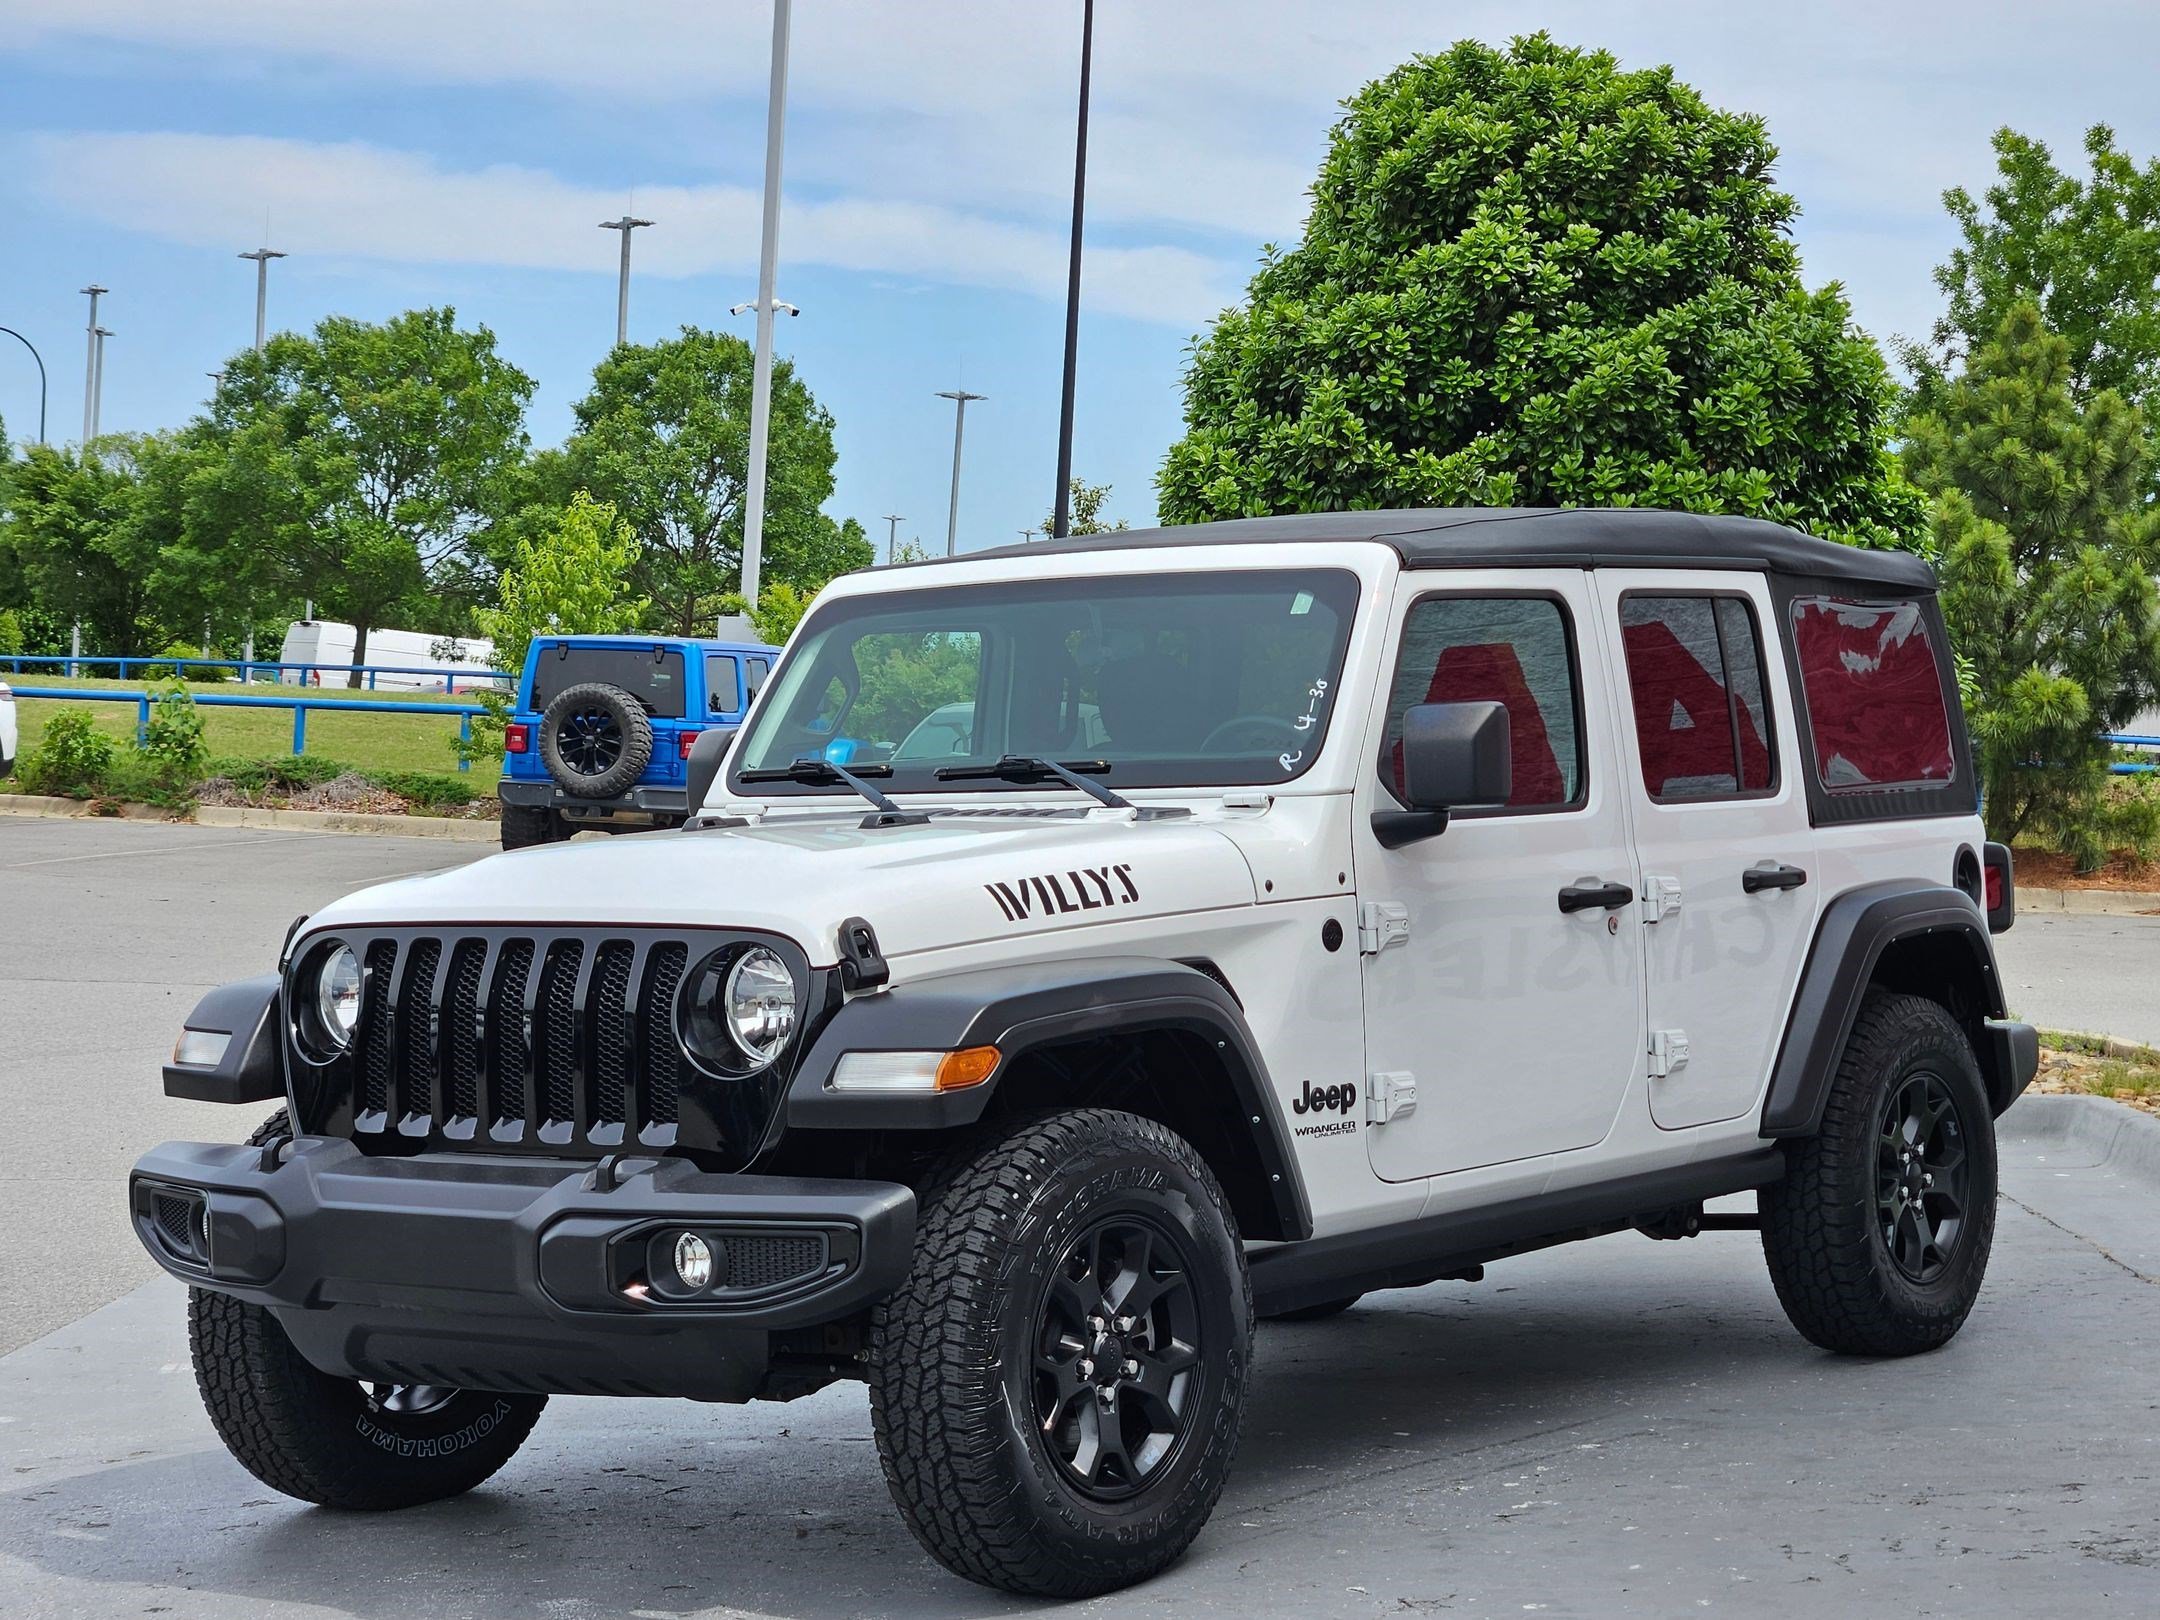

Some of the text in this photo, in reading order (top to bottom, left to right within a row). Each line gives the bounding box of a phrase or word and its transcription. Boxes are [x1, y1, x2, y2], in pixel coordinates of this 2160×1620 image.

[1279, 678, 1328, 771] R 4-30
[984, 863, 1139, 921] WILLYS
[1292, 1080, 1356, 1115] Jeep
[1294, 1120, 1356, 1137] WRANGLER
[1314, 1128, 1357, 1139] UNLIMITED
[1029, 1165, 1170, 1278] YOKOHAMA
[355, 1399, 512, 1458] YOKOHAMA
